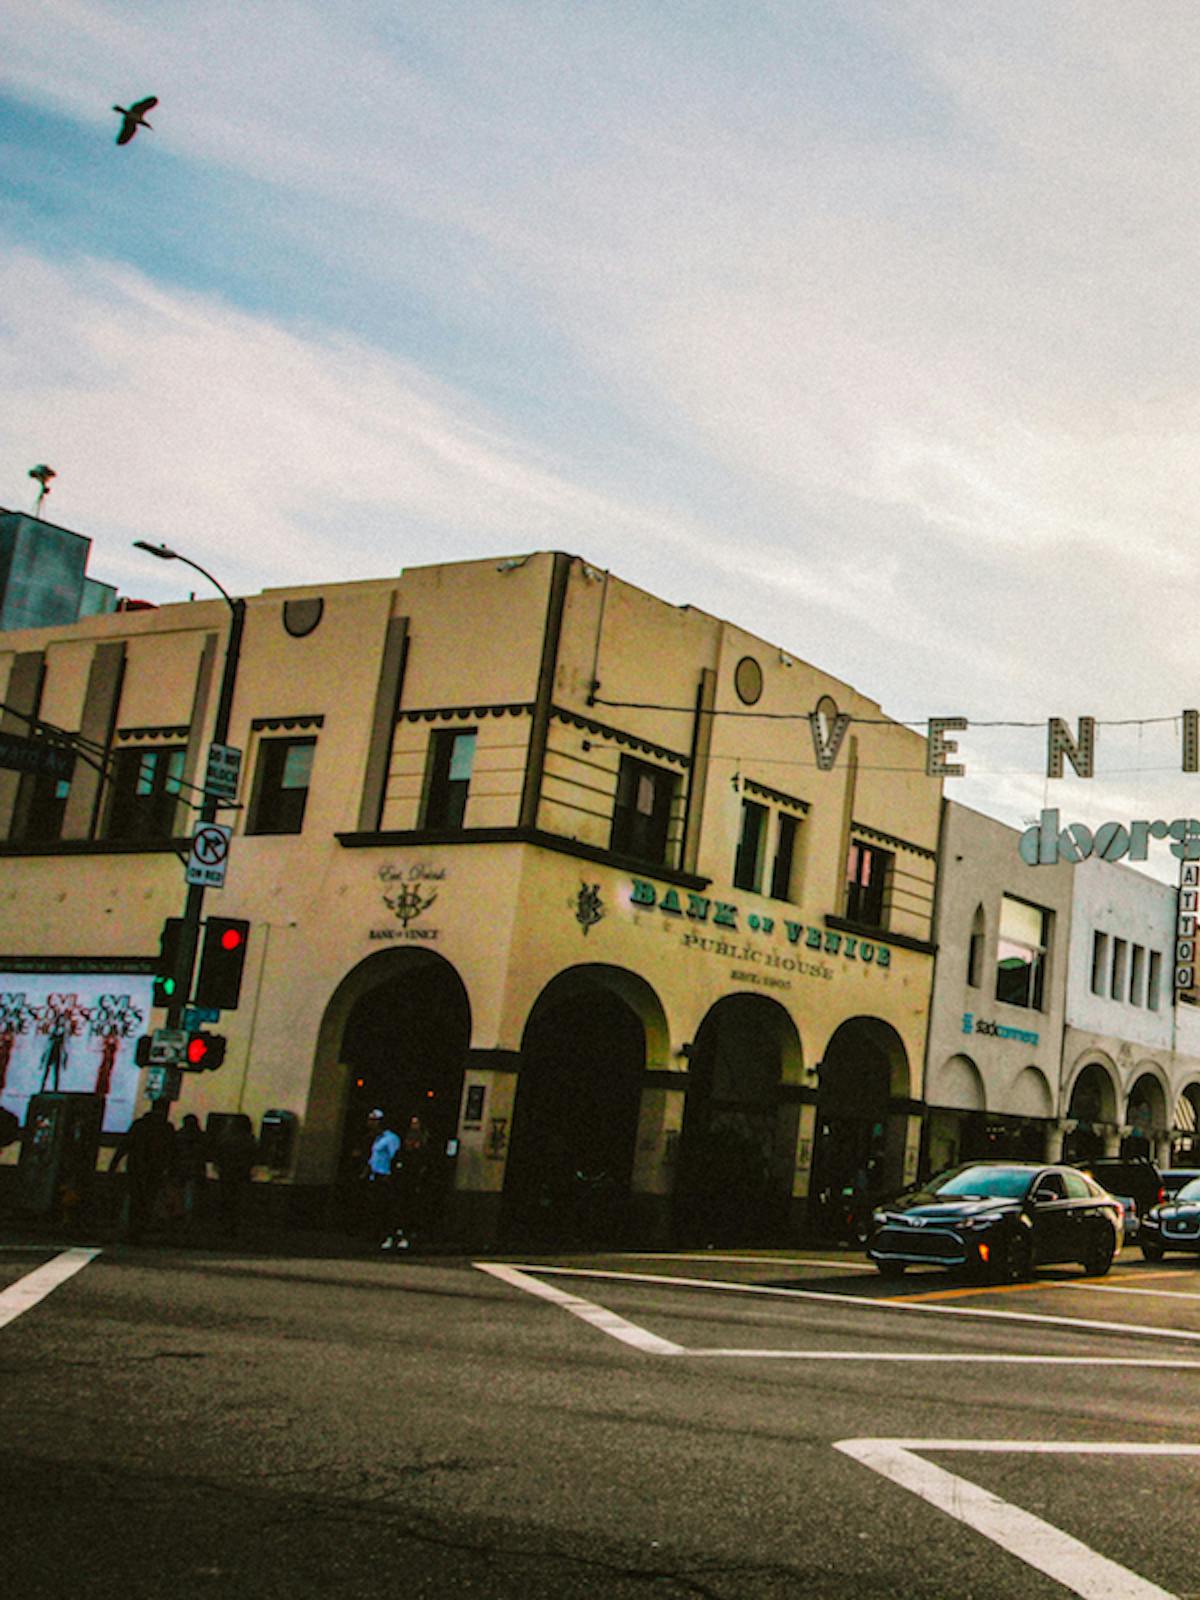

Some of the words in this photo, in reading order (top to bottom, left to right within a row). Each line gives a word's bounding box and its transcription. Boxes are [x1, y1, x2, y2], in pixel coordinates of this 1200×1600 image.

[630, 878, 738, 930] BANK
[783, 919, 892, 969] VENICE
[683, 933, 762, 964] PUBLIC
[765, 952, 834, 981] HOUSE
[1176, 865, 1196, 987] ATTOO
